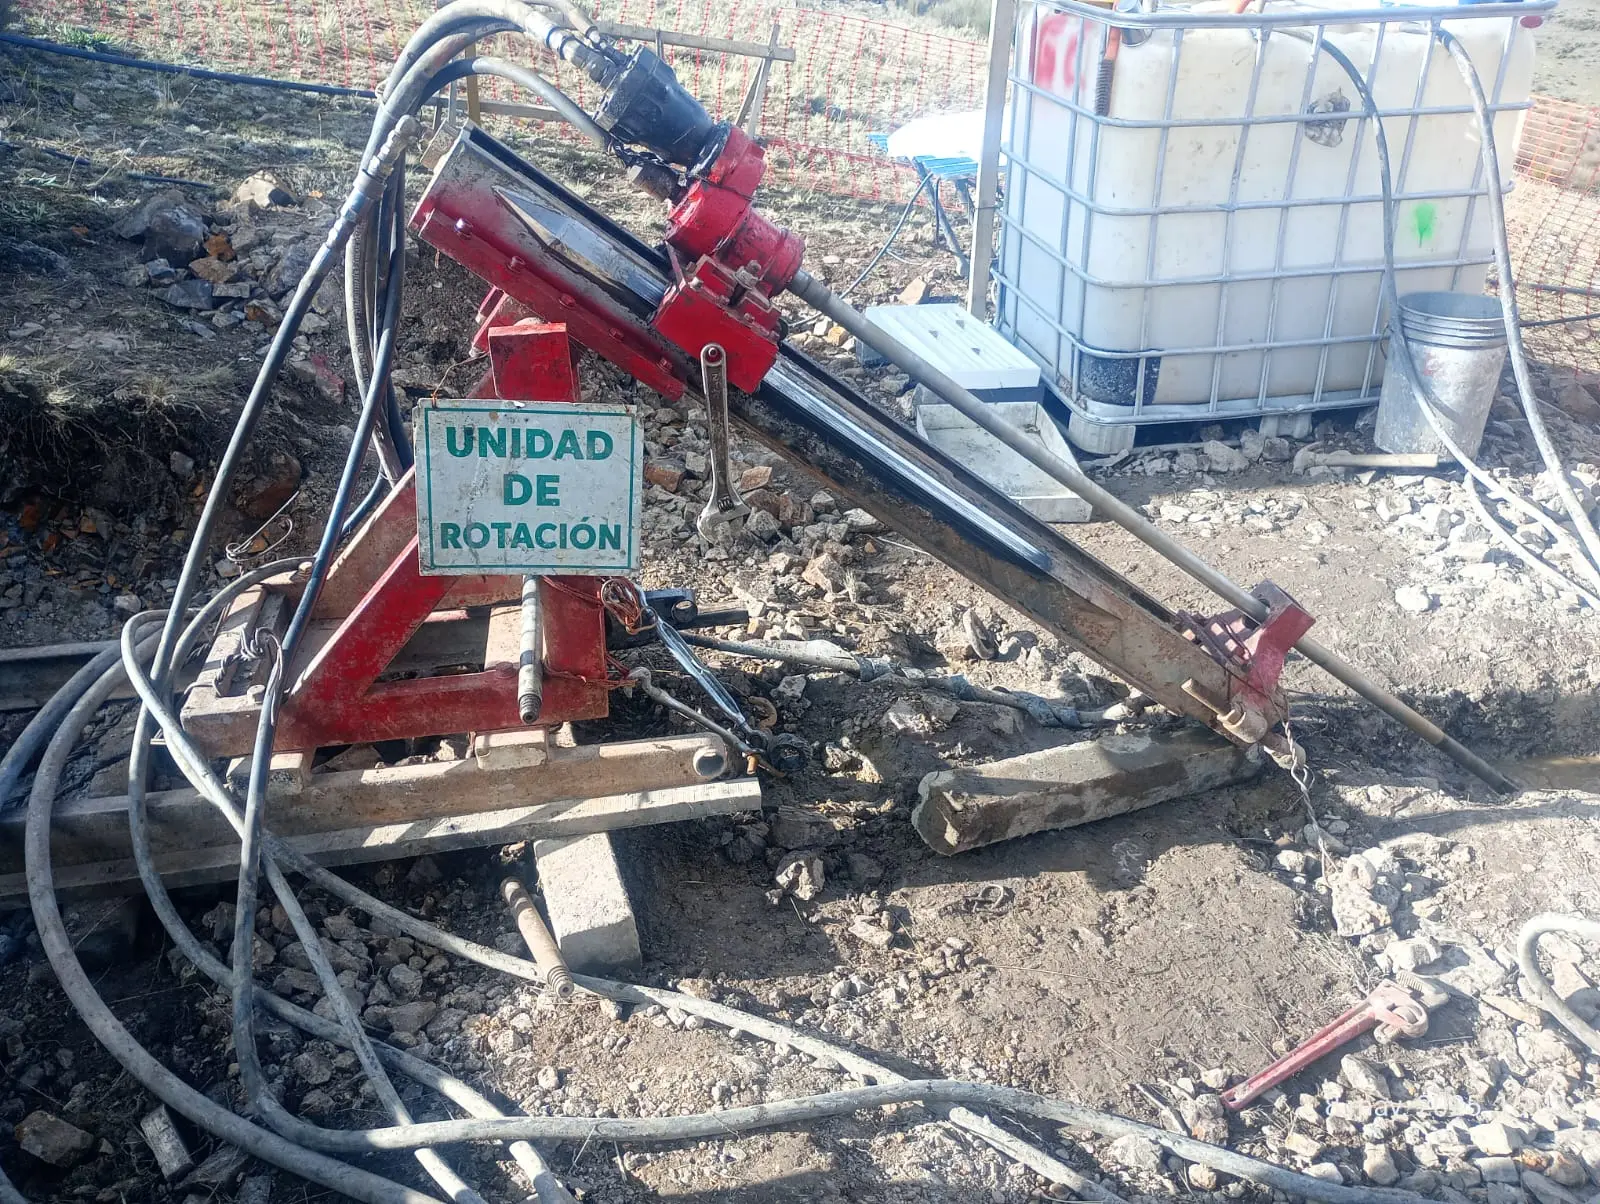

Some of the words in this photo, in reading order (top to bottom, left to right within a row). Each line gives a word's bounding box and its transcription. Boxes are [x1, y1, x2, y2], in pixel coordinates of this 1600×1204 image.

[446, 426, 614, 460] UNIDAD
[503, 473, 561, 507] DE
[440, 516, 622, 550] ROTACIÓN
